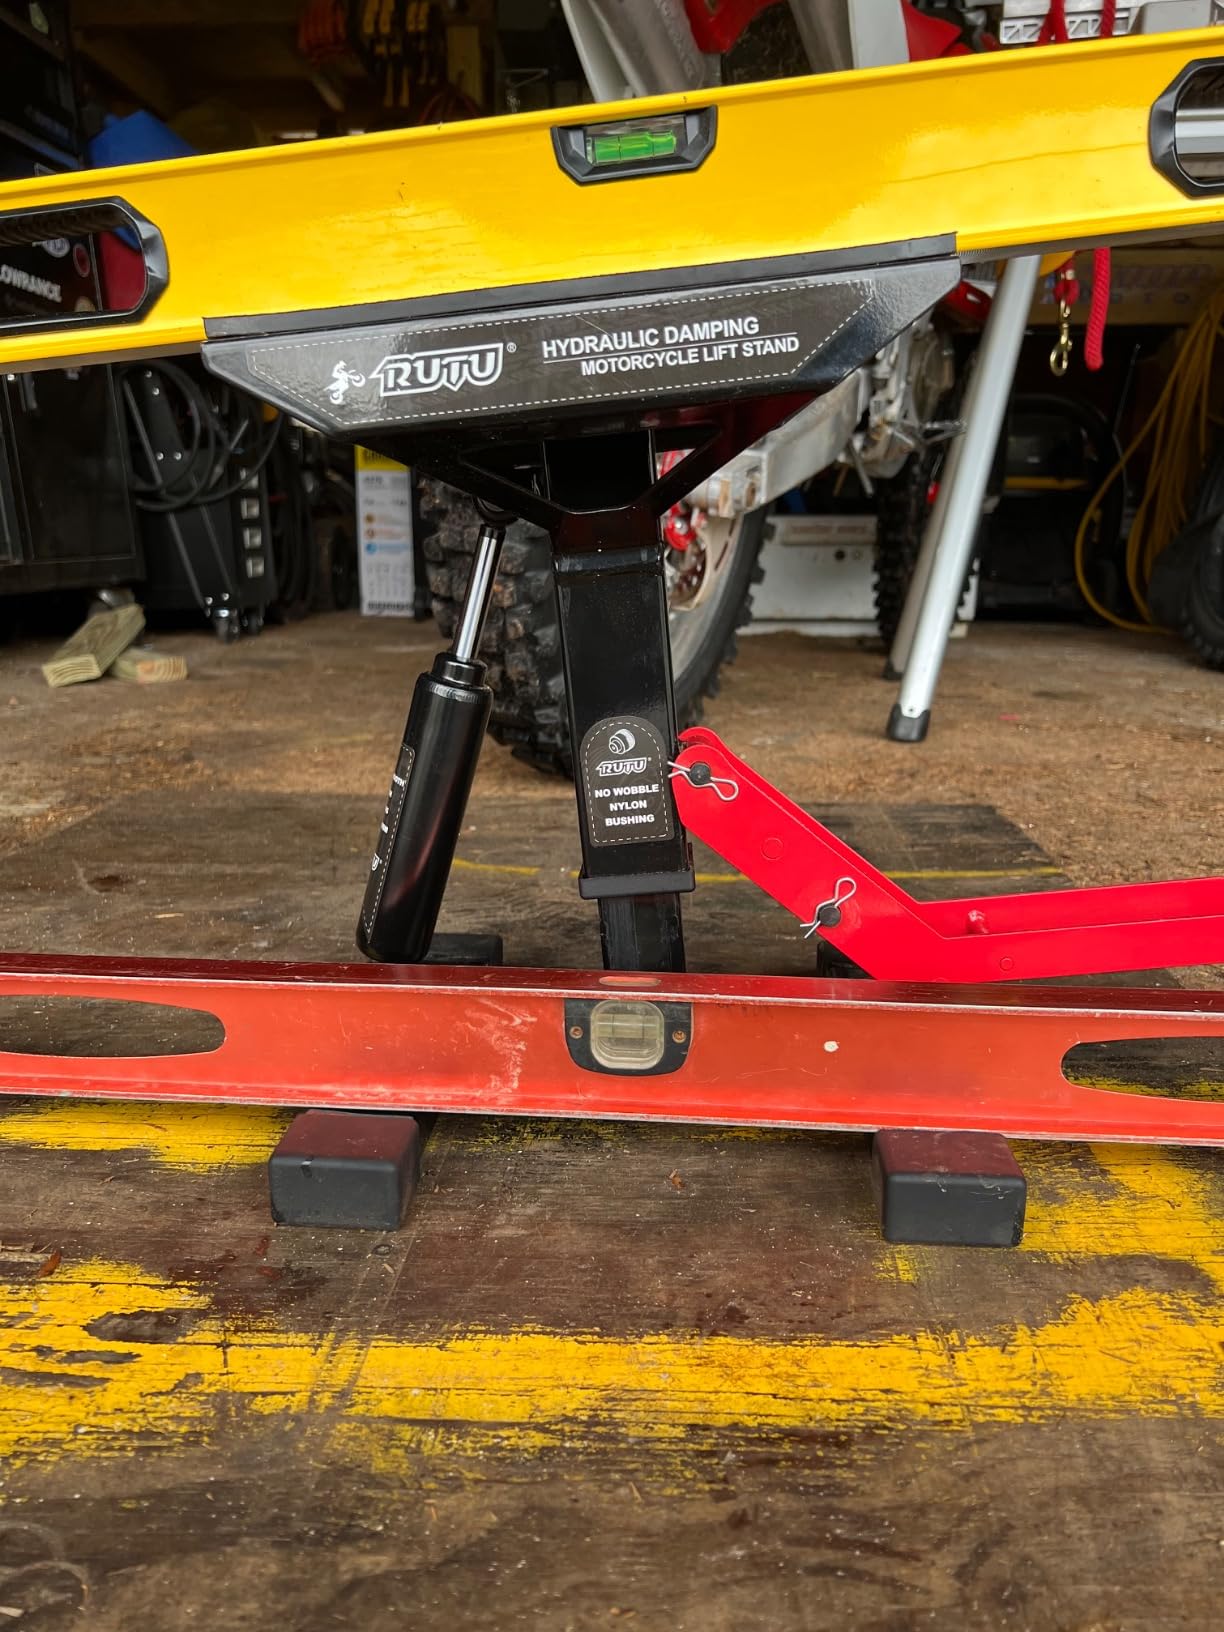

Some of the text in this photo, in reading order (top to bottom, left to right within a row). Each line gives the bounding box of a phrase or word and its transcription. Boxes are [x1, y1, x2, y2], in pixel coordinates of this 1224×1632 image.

[541, 316, 760, 359] HYDRAULIC DAMPING
[581, 336, 800, 376] MOTORCYCLE LIFT STAND
[594, 784, 659, 798] NO WOBBLE
[609, 800, 647, 811] NYLON
[605, 814, 655, 826] BUSHING
